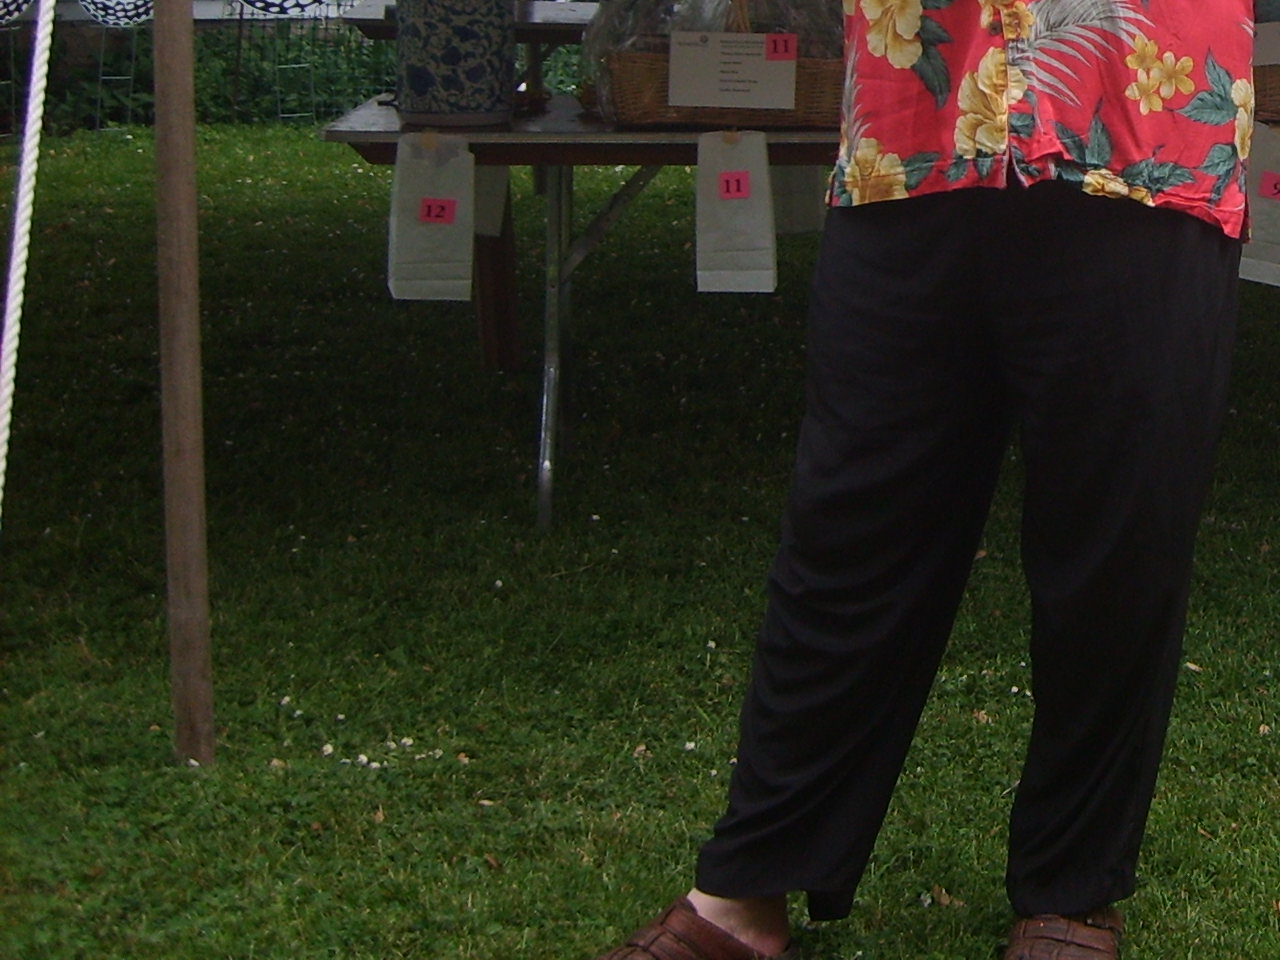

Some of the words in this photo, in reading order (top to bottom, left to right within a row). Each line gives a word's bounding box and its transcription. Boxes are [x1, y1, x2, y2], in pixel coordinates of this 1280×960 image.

[772, 39, 789, 53] 11
[724, 178, 742, 193] 11
[426, 204, 446, 218] 12
